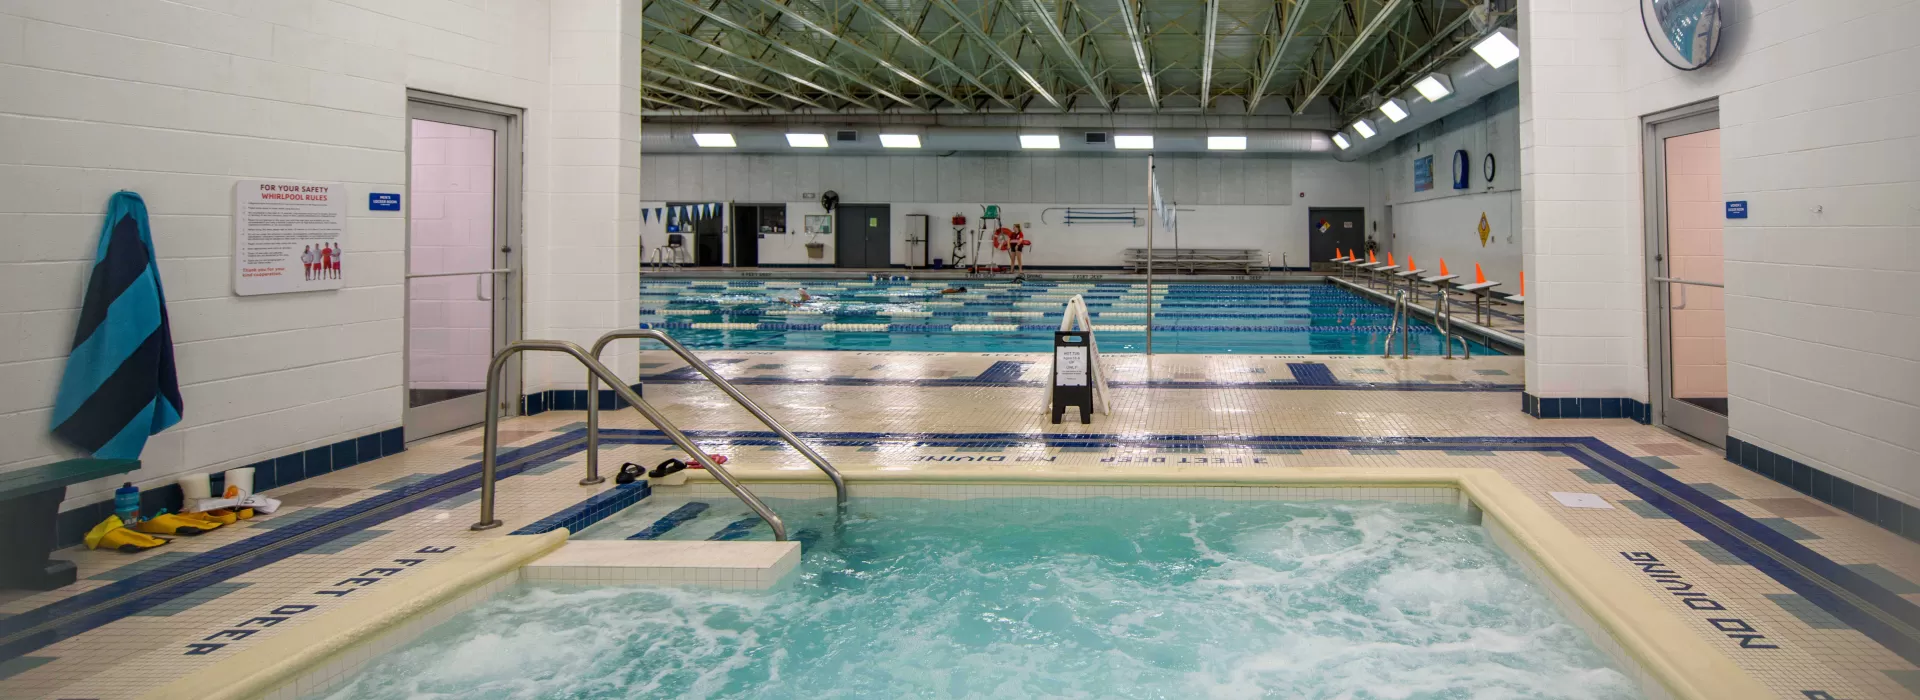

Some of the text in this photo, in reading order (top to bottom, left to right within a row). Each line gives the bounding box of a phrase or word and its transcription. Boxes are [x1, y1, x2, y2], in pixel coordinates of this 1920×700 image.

[182, 545, 457, 656] 3 FEET DEEP
[1619, 551, 1781, 650] NO DIVING
